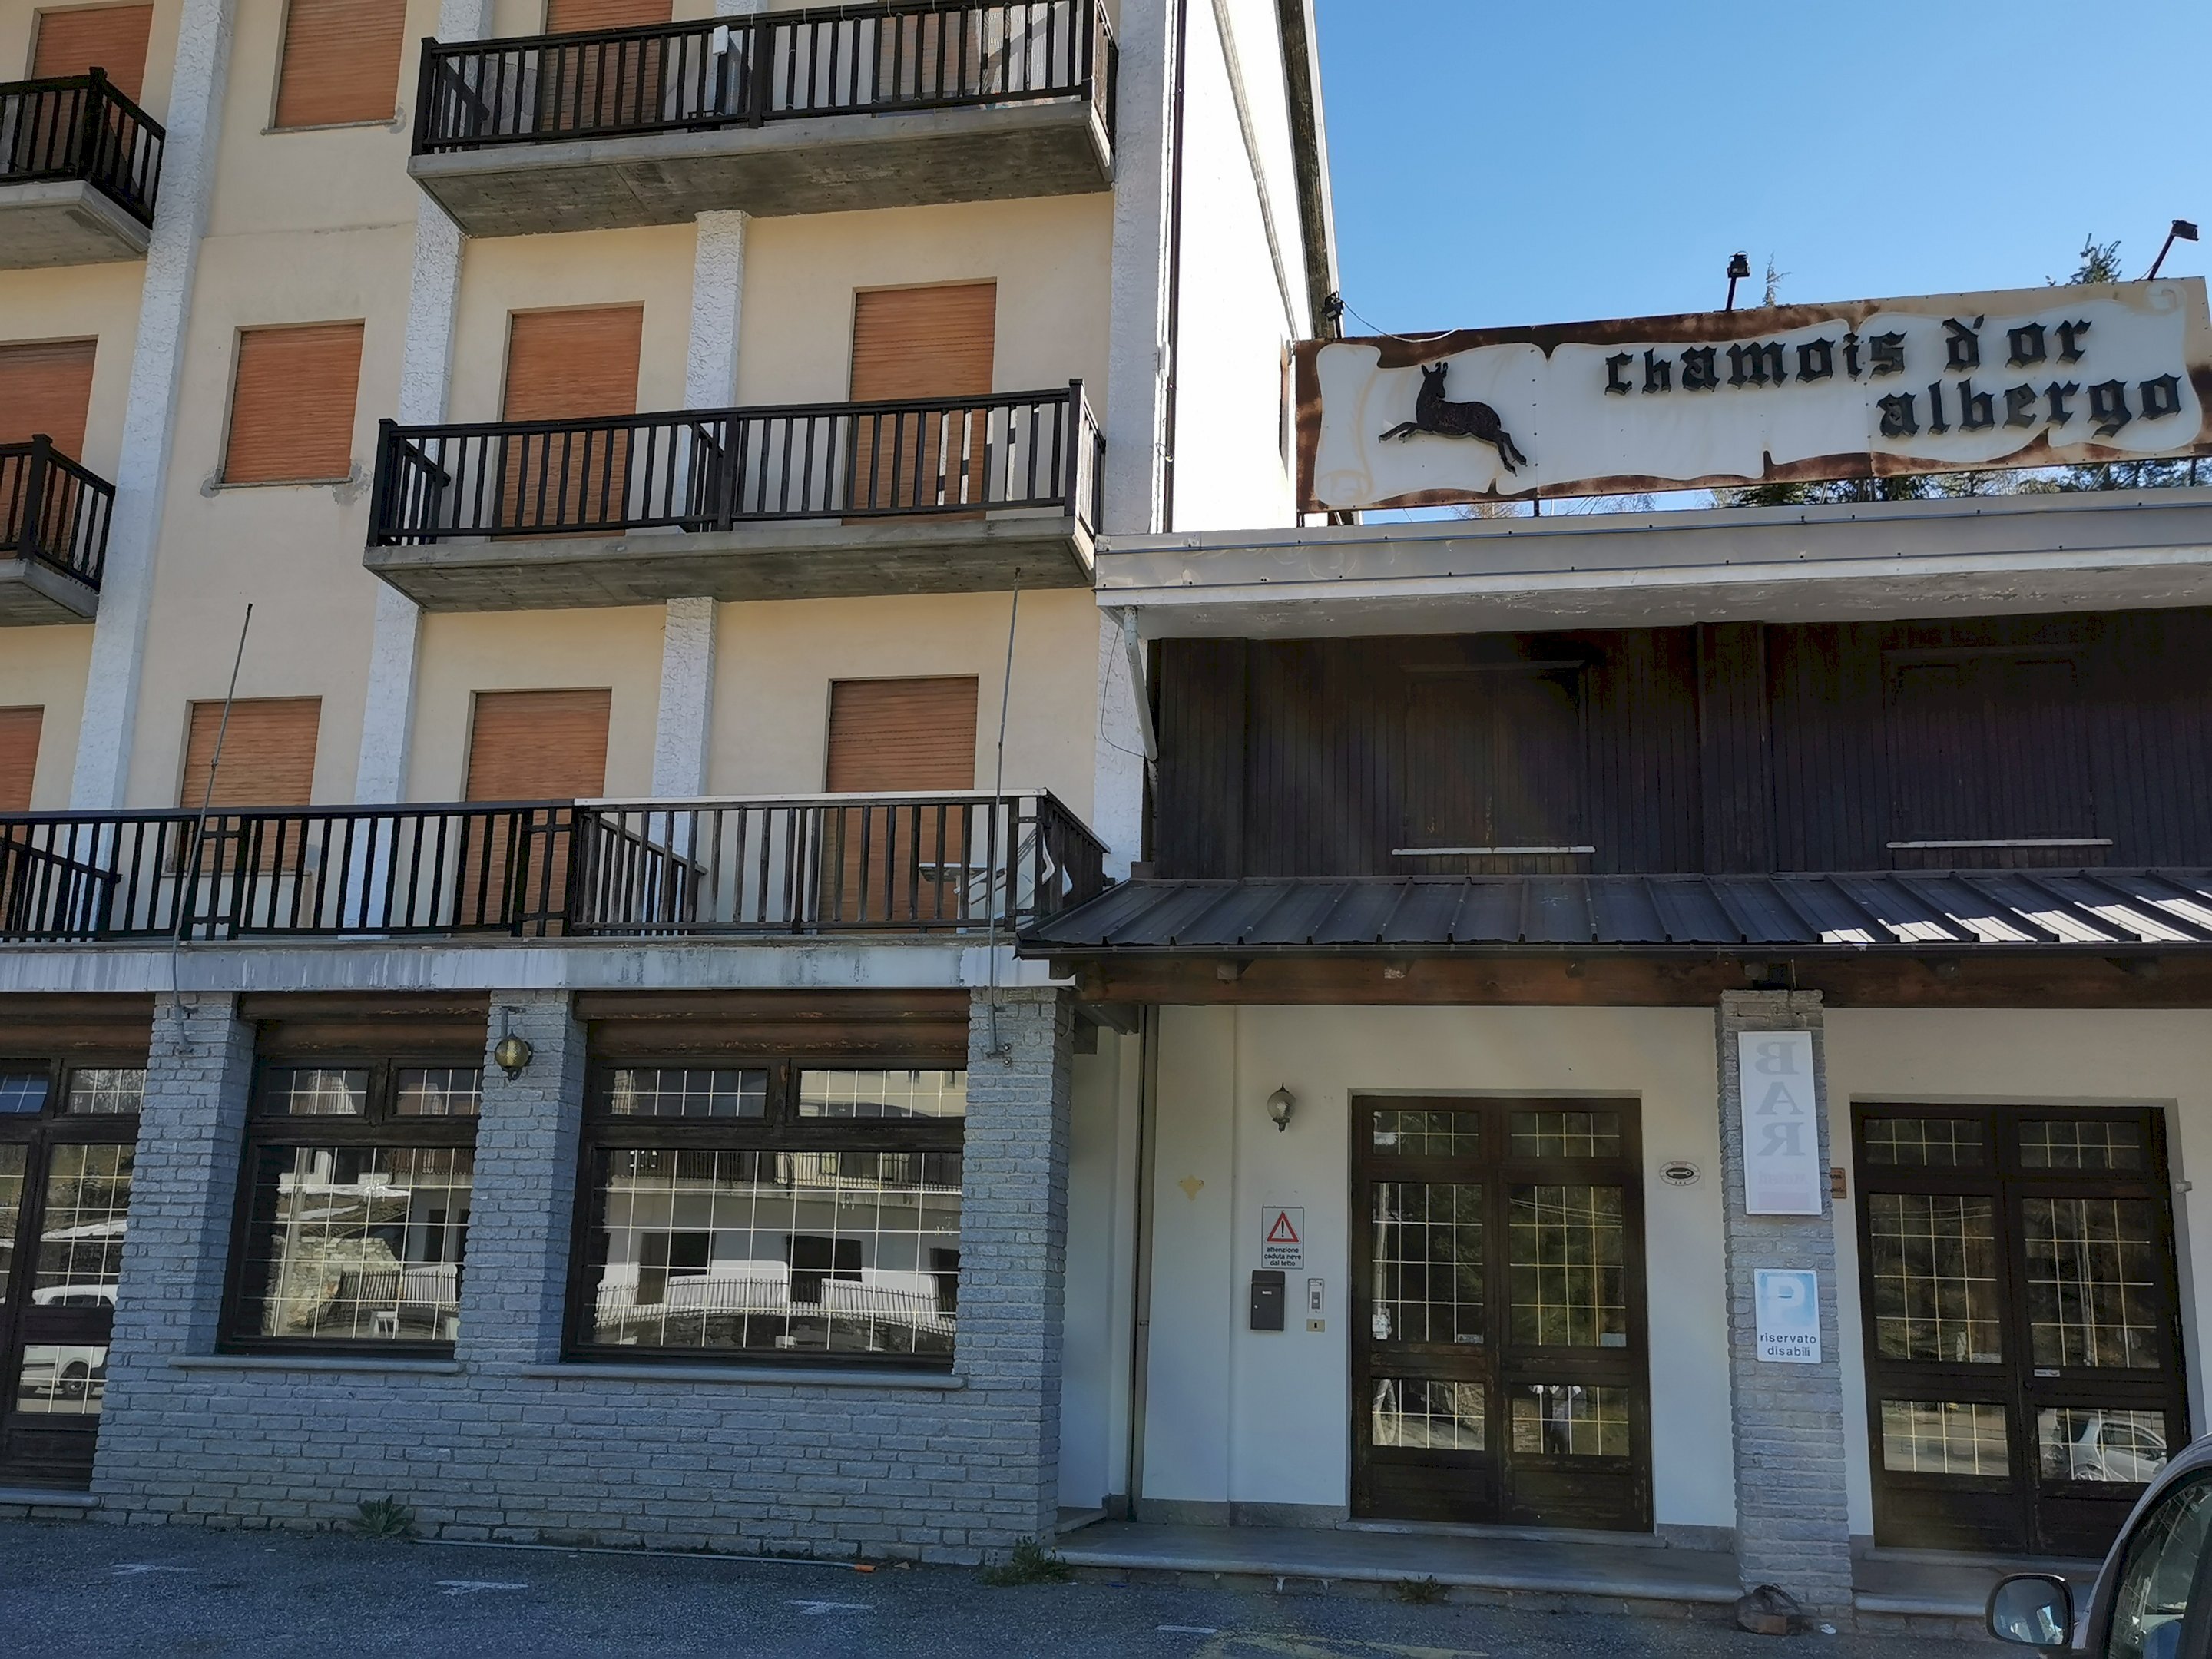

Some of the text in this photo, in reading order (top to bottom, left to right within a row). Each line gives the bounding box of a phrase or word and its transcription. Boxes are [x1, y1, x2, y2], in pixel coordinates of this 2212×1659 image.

[1604, 330, 1908, 396] chamois
[1876, 373, 2183, 439] albergo
[1767, 1277, 1805, 1323] P
[1760, 1333, 1816, 1344] riservato
[1767, 1346, 1811, 1357] disabili
